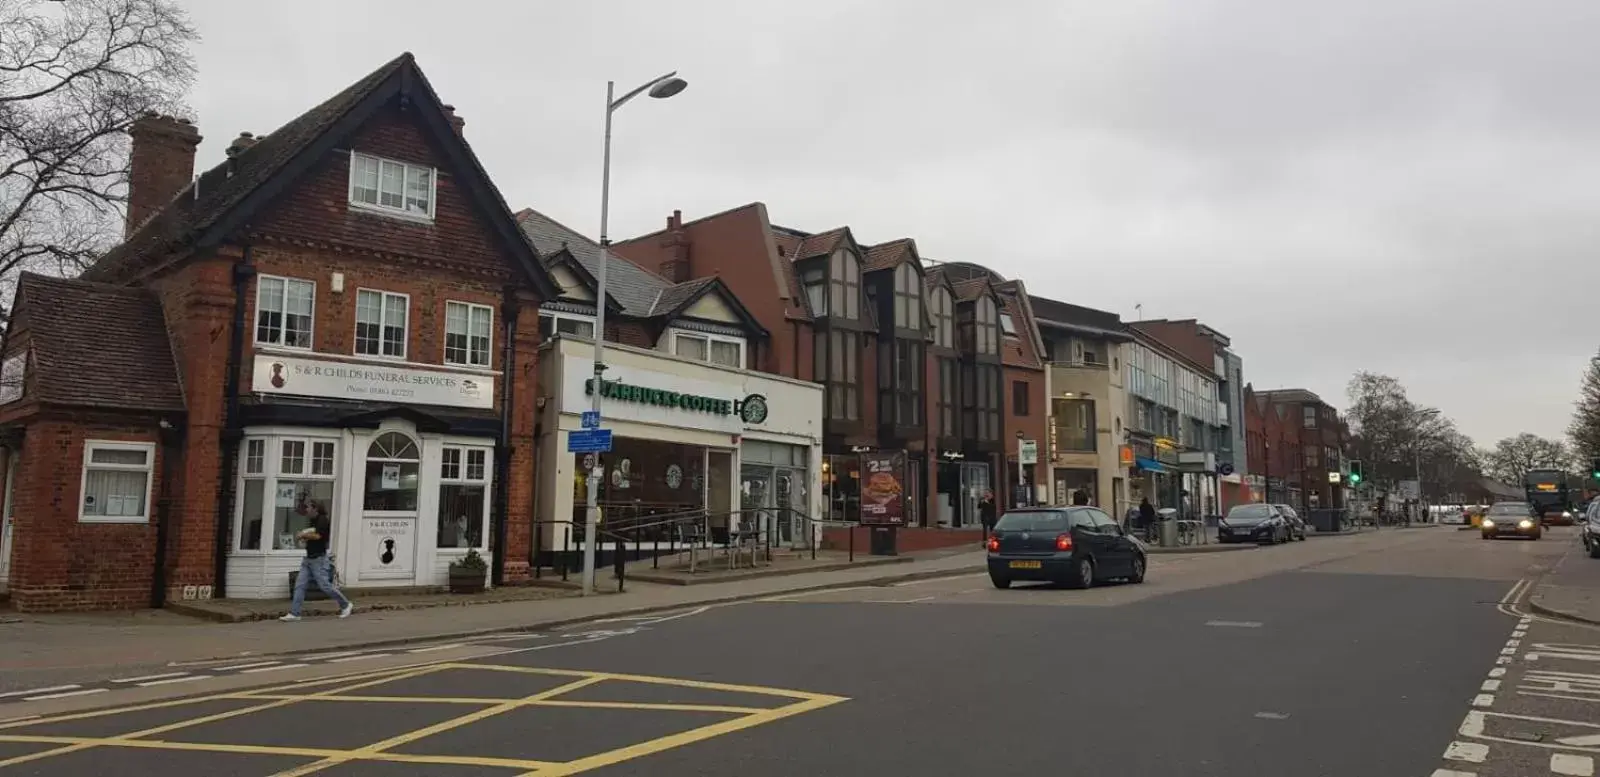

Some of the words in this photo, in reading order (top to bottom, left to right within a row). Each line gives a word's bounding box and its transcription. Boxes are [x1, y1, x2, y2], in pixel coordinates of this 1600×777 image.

[294, 364, 301, 375] S
[303, 366, 313, 376] &
[314, 366, 322, 377] R
[323, 366, 363, 379] CHILDS
[364, 369, 410, 384] FUNERAL
[412, 374, 457, 387] SERVICES
[585, 378, 680, 409] SARBUCKS
[680, 393, 732, 416] COFFEE
